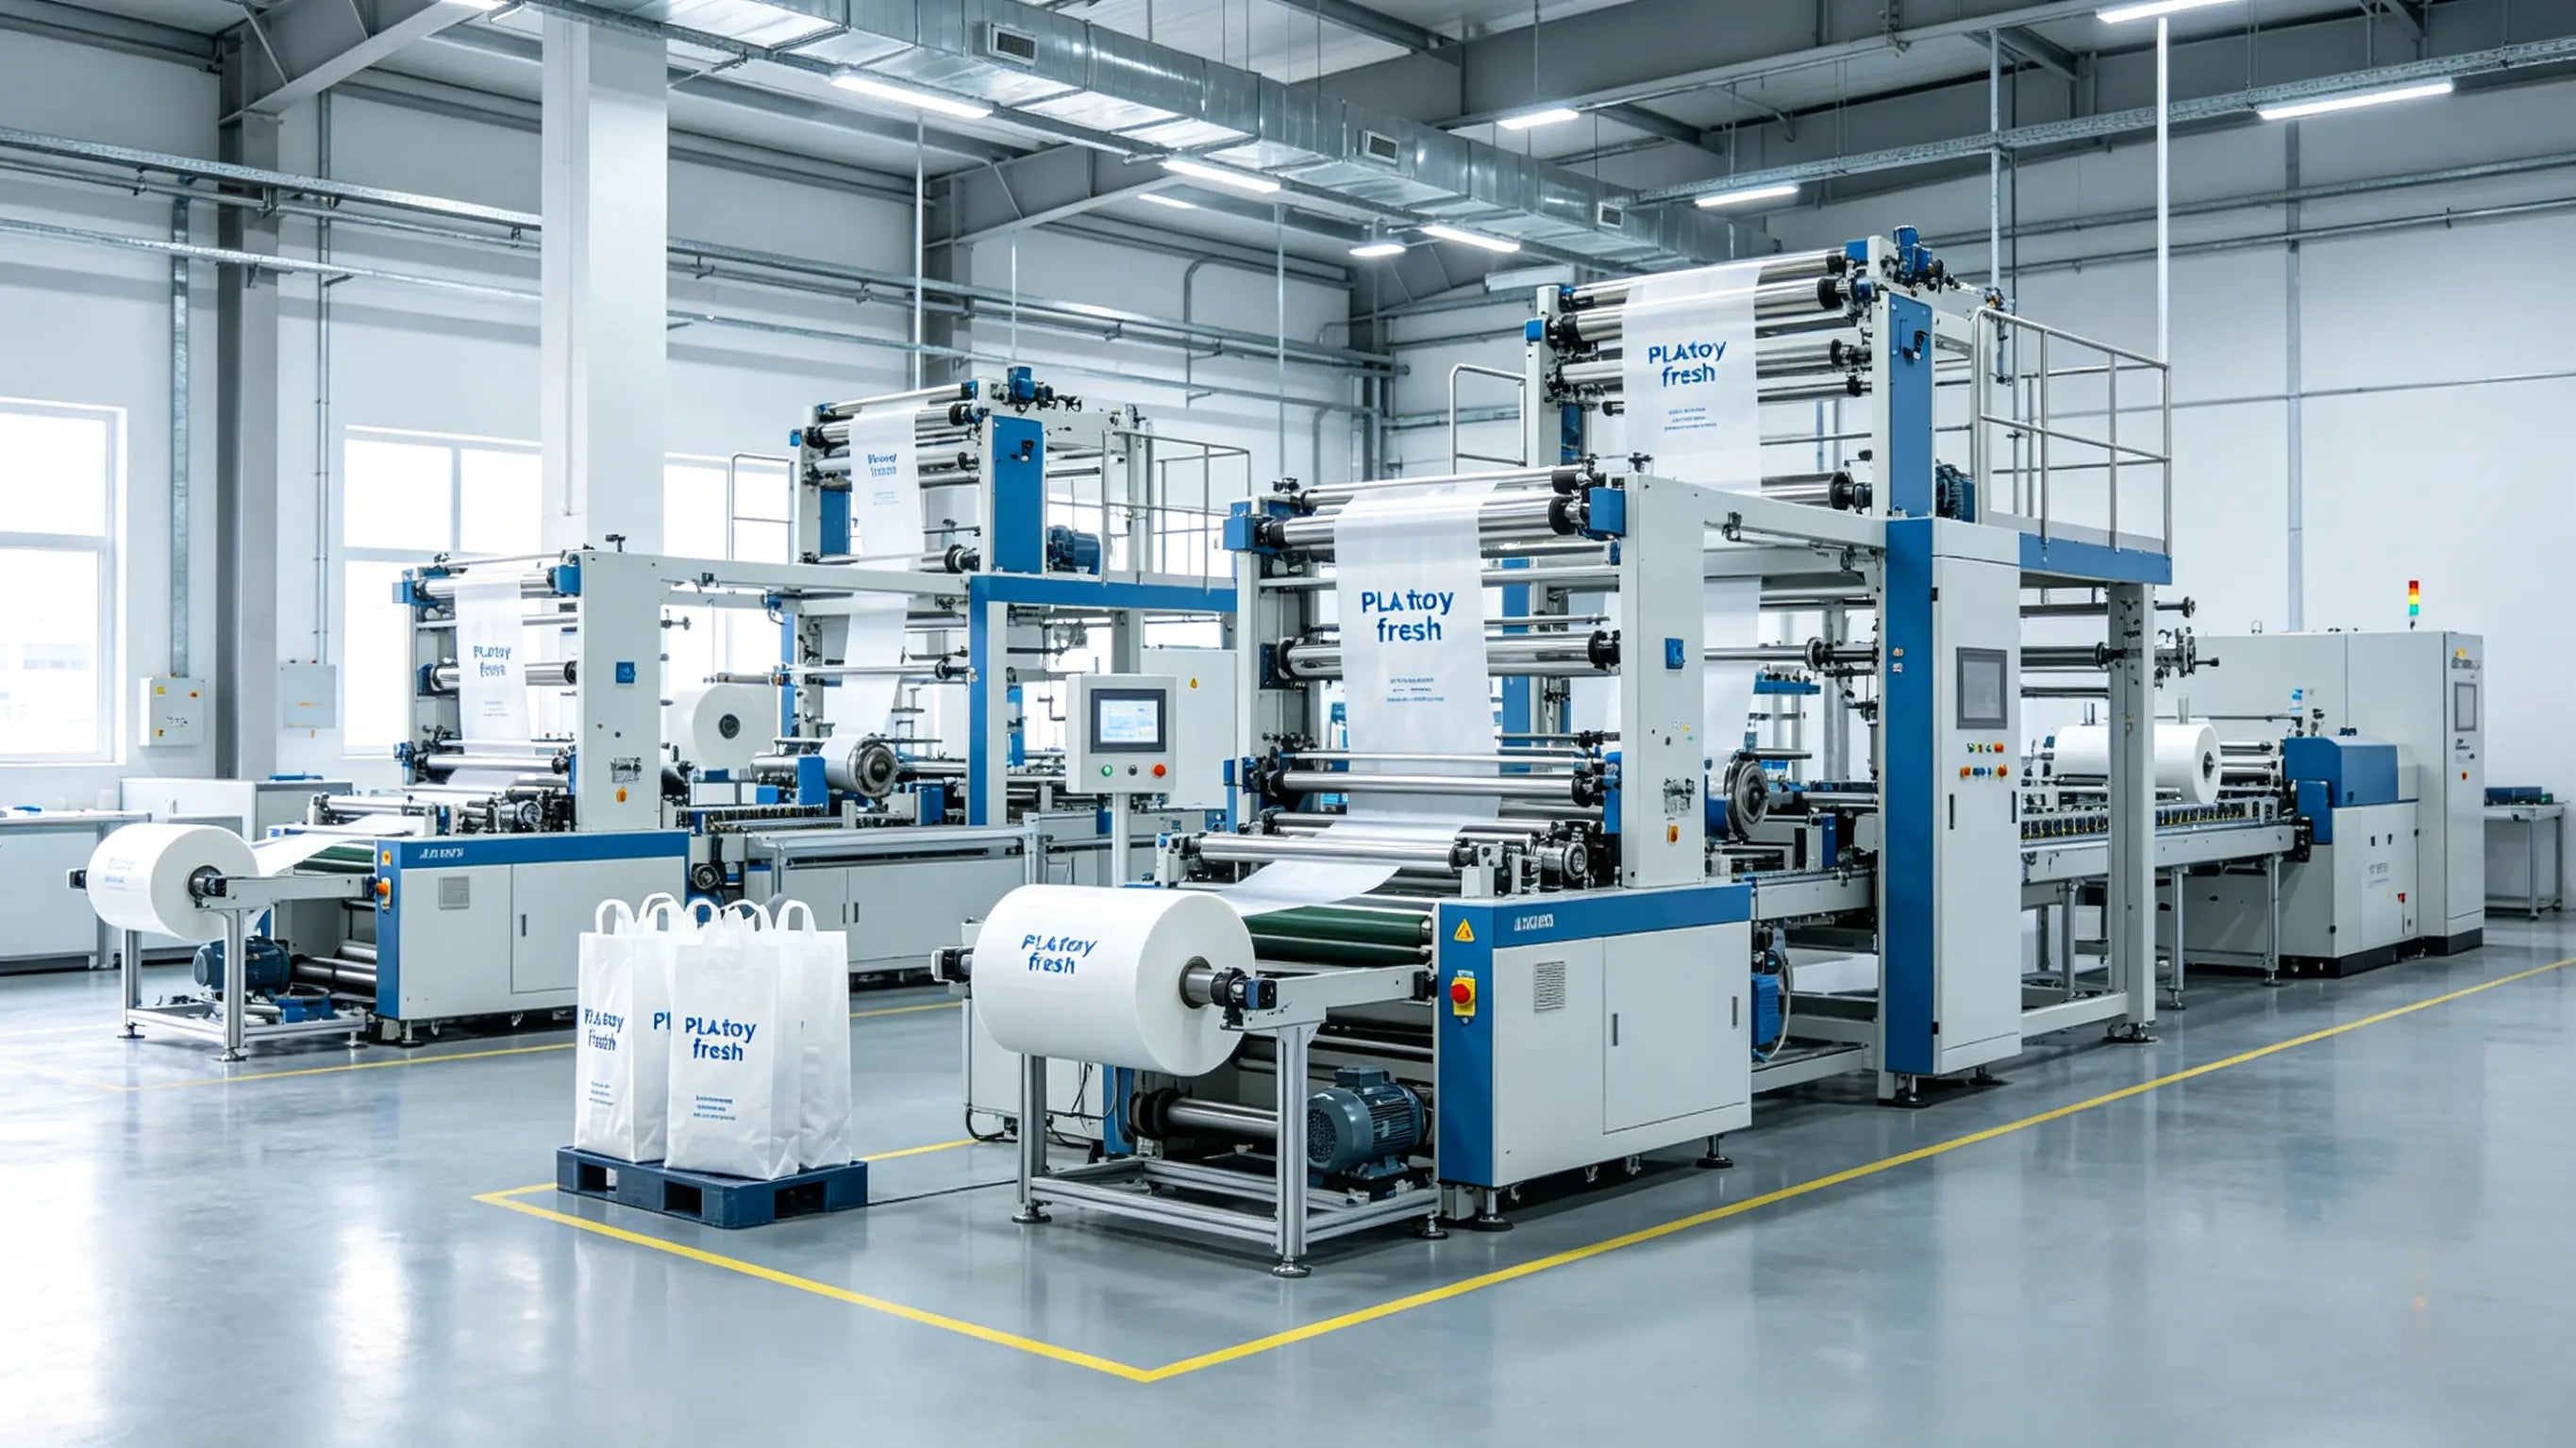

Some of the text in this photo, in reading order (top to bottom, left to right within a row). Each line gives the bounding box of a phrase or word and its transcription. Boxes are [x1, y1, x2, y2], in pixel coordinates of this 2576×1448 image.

[1648, 341, 1727, 364] PLAtoy
[1662, 363, 1715, 388] fresh
[1377, 615, 1442, 642] fresh
[685, 1017, 757, 1043] PLAtoy
[693, 1039, 744, 1061] fresh
